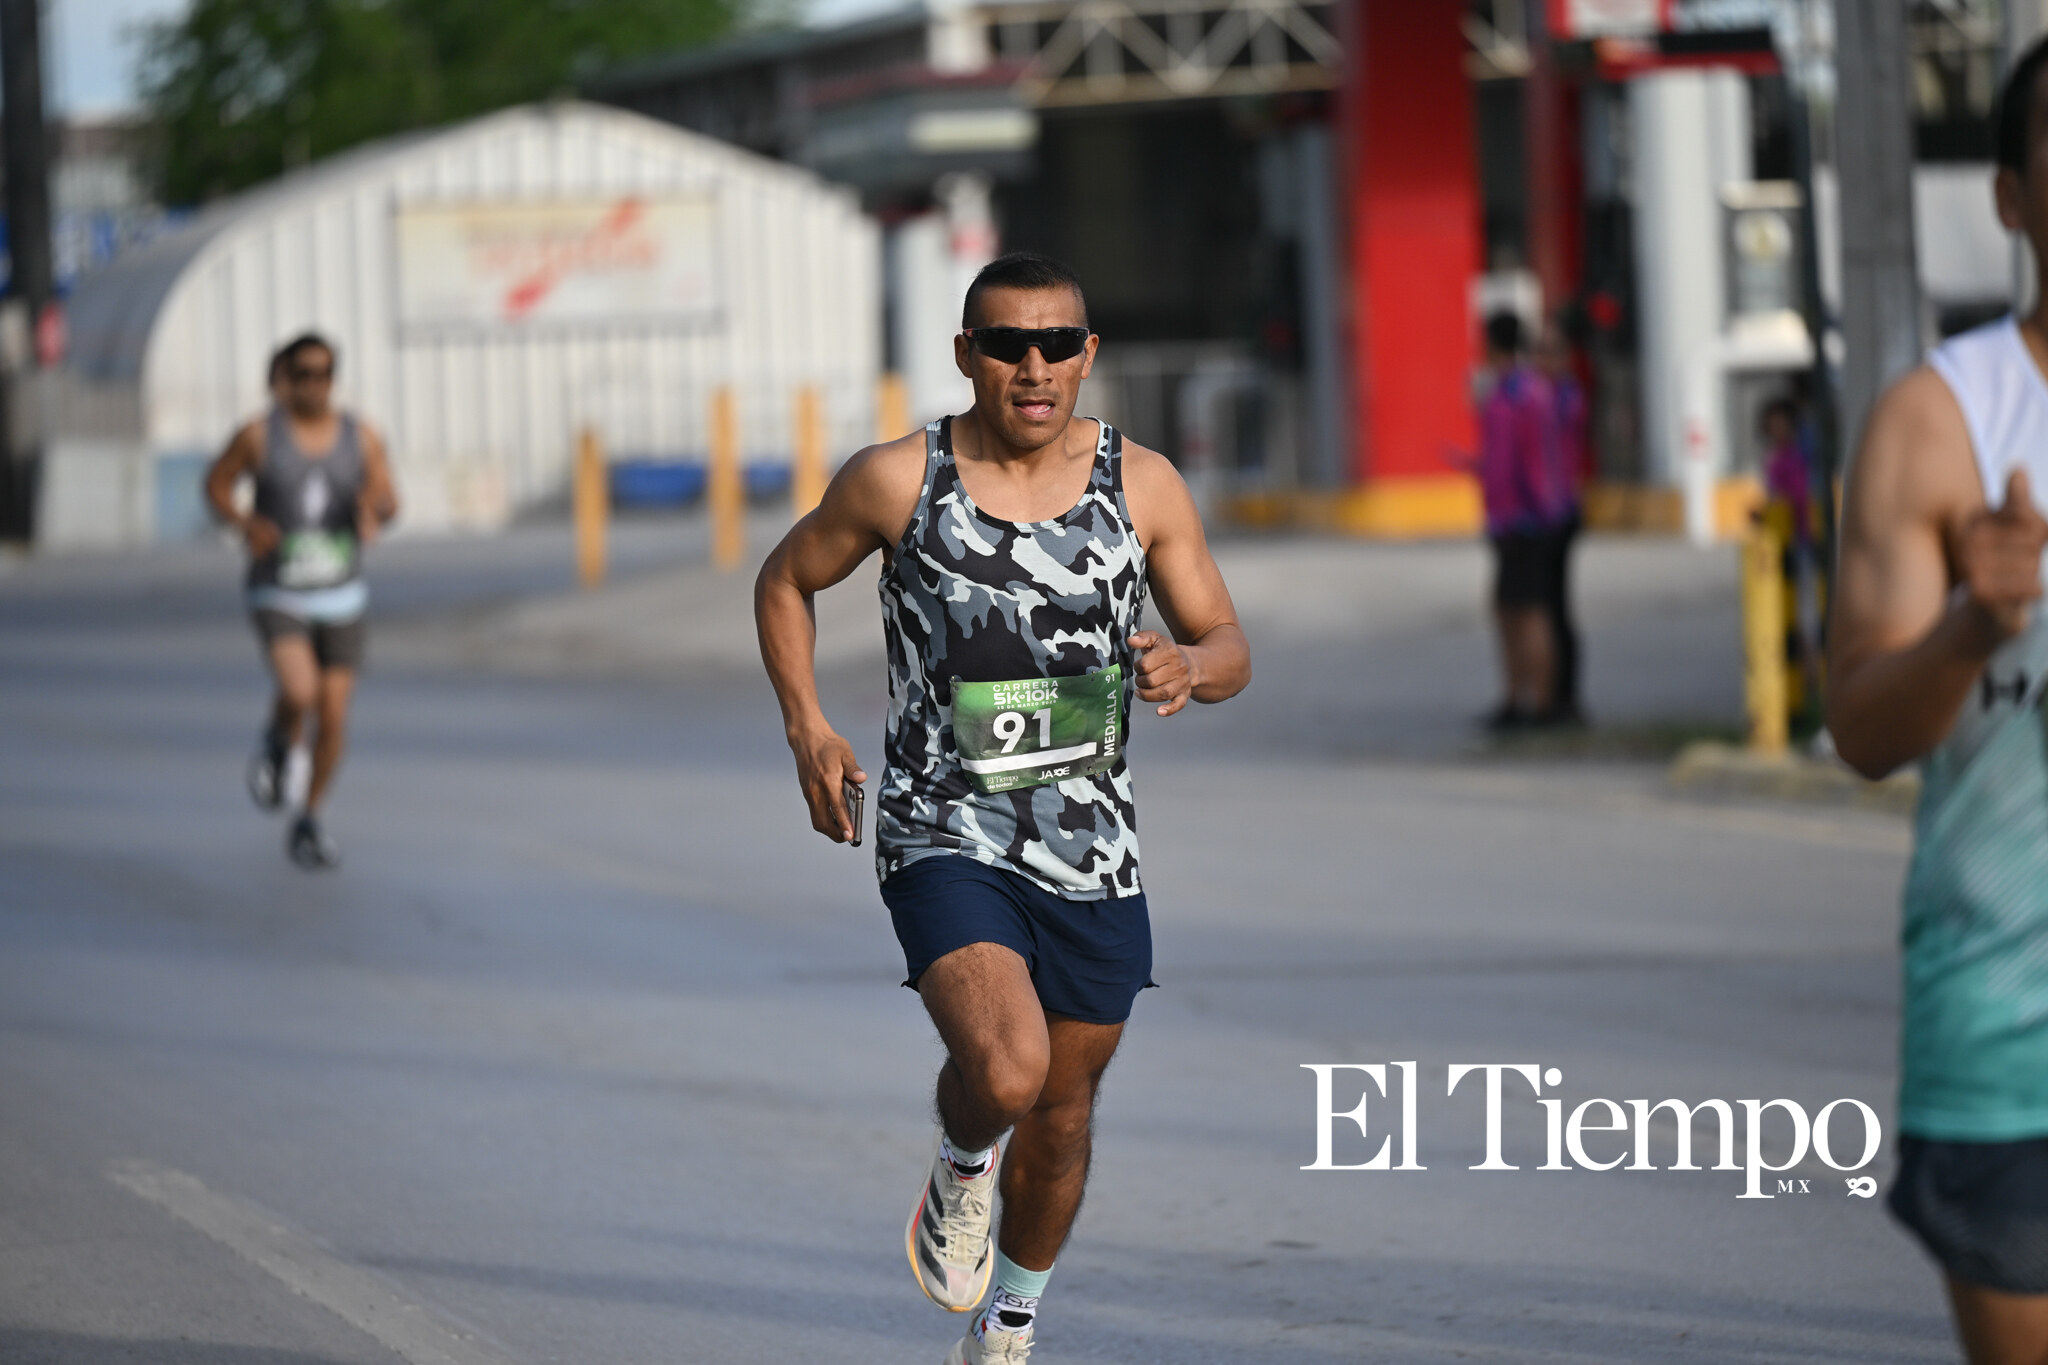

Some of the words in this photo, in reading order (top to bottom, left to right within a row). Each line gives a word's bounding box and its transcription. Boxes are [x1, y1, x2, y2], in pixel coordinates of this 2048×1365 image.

[993, 680, 1058, 692] CARRERA
[1105, 673, 1116, 684] 91
[992, 707, 1052, 754] 91
[1103, 688, 1117, 757] MEDALLA
